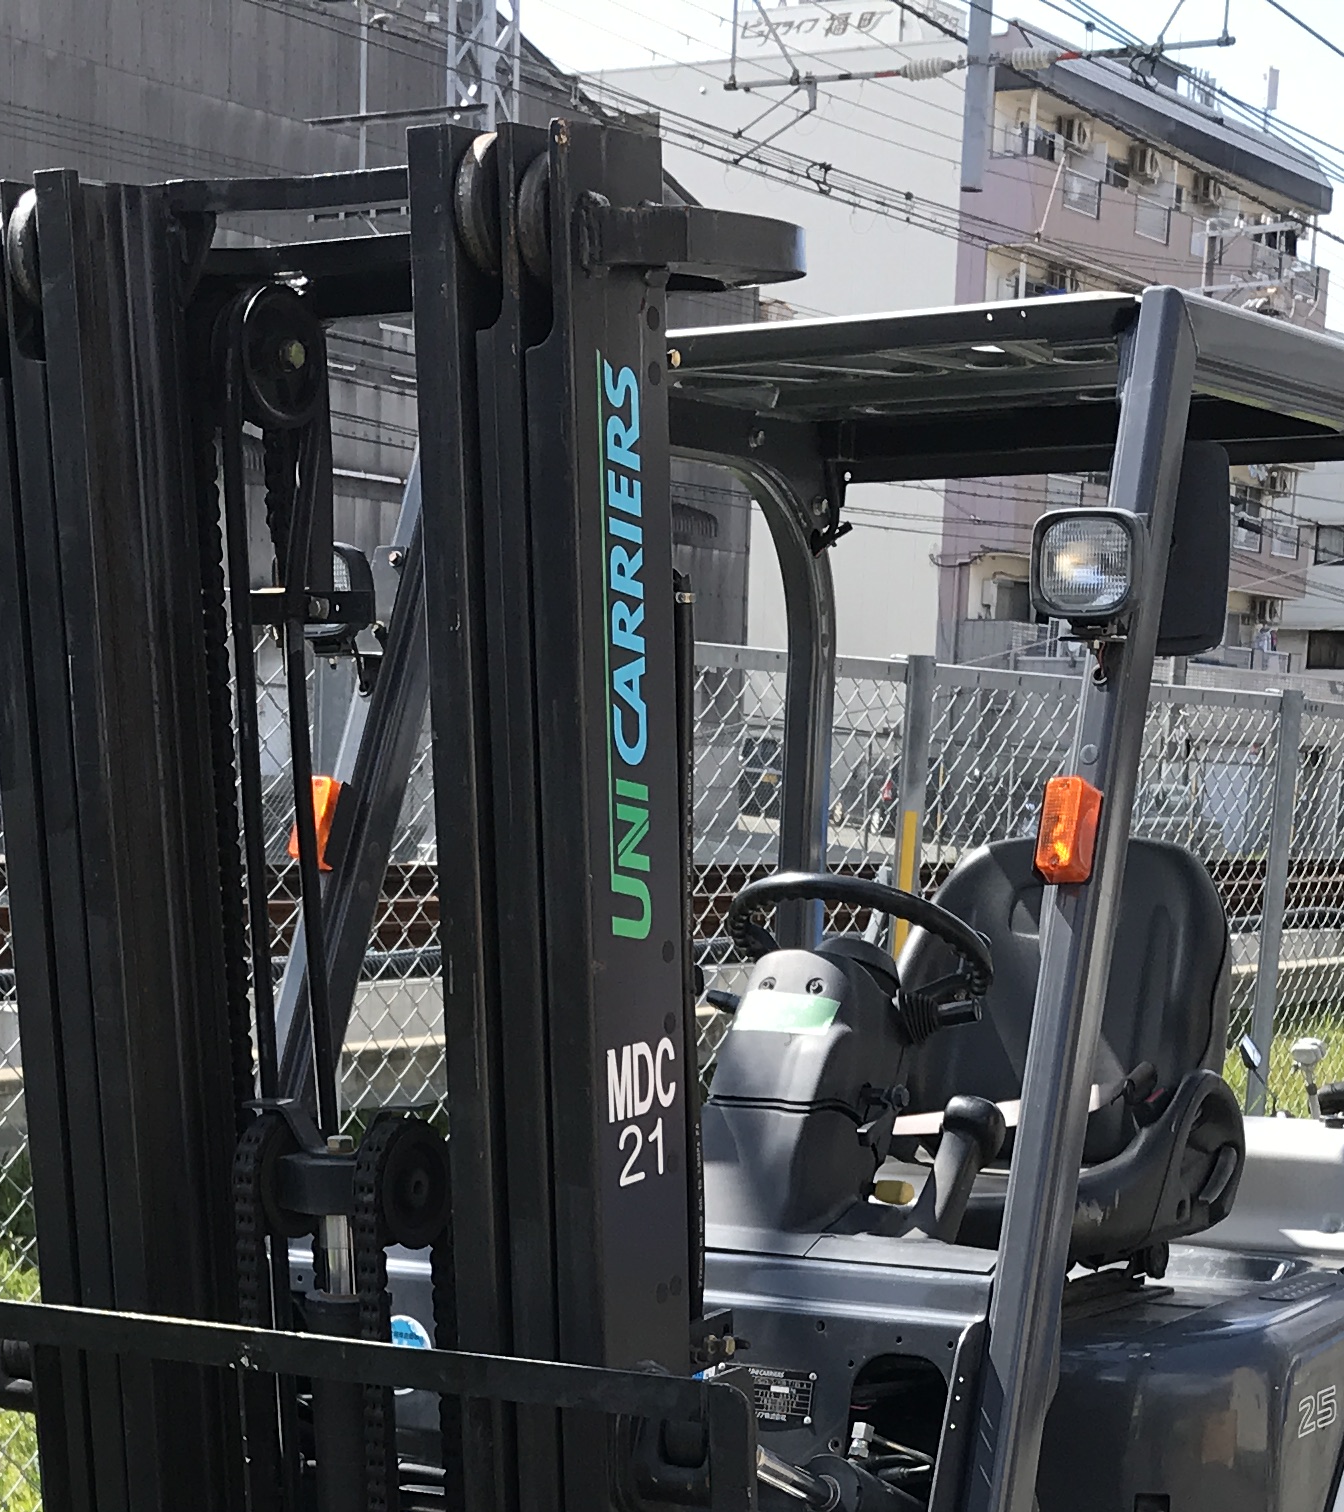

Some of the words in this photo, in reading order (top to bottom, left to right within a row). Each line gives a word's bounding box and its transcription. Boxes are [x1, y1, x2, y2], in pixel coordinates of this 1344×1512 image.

[606, 1037, 676, 1123] MDC
[618, 1117, 664, 1187] 21
[1298, 1385, 1337, 1438] 25
